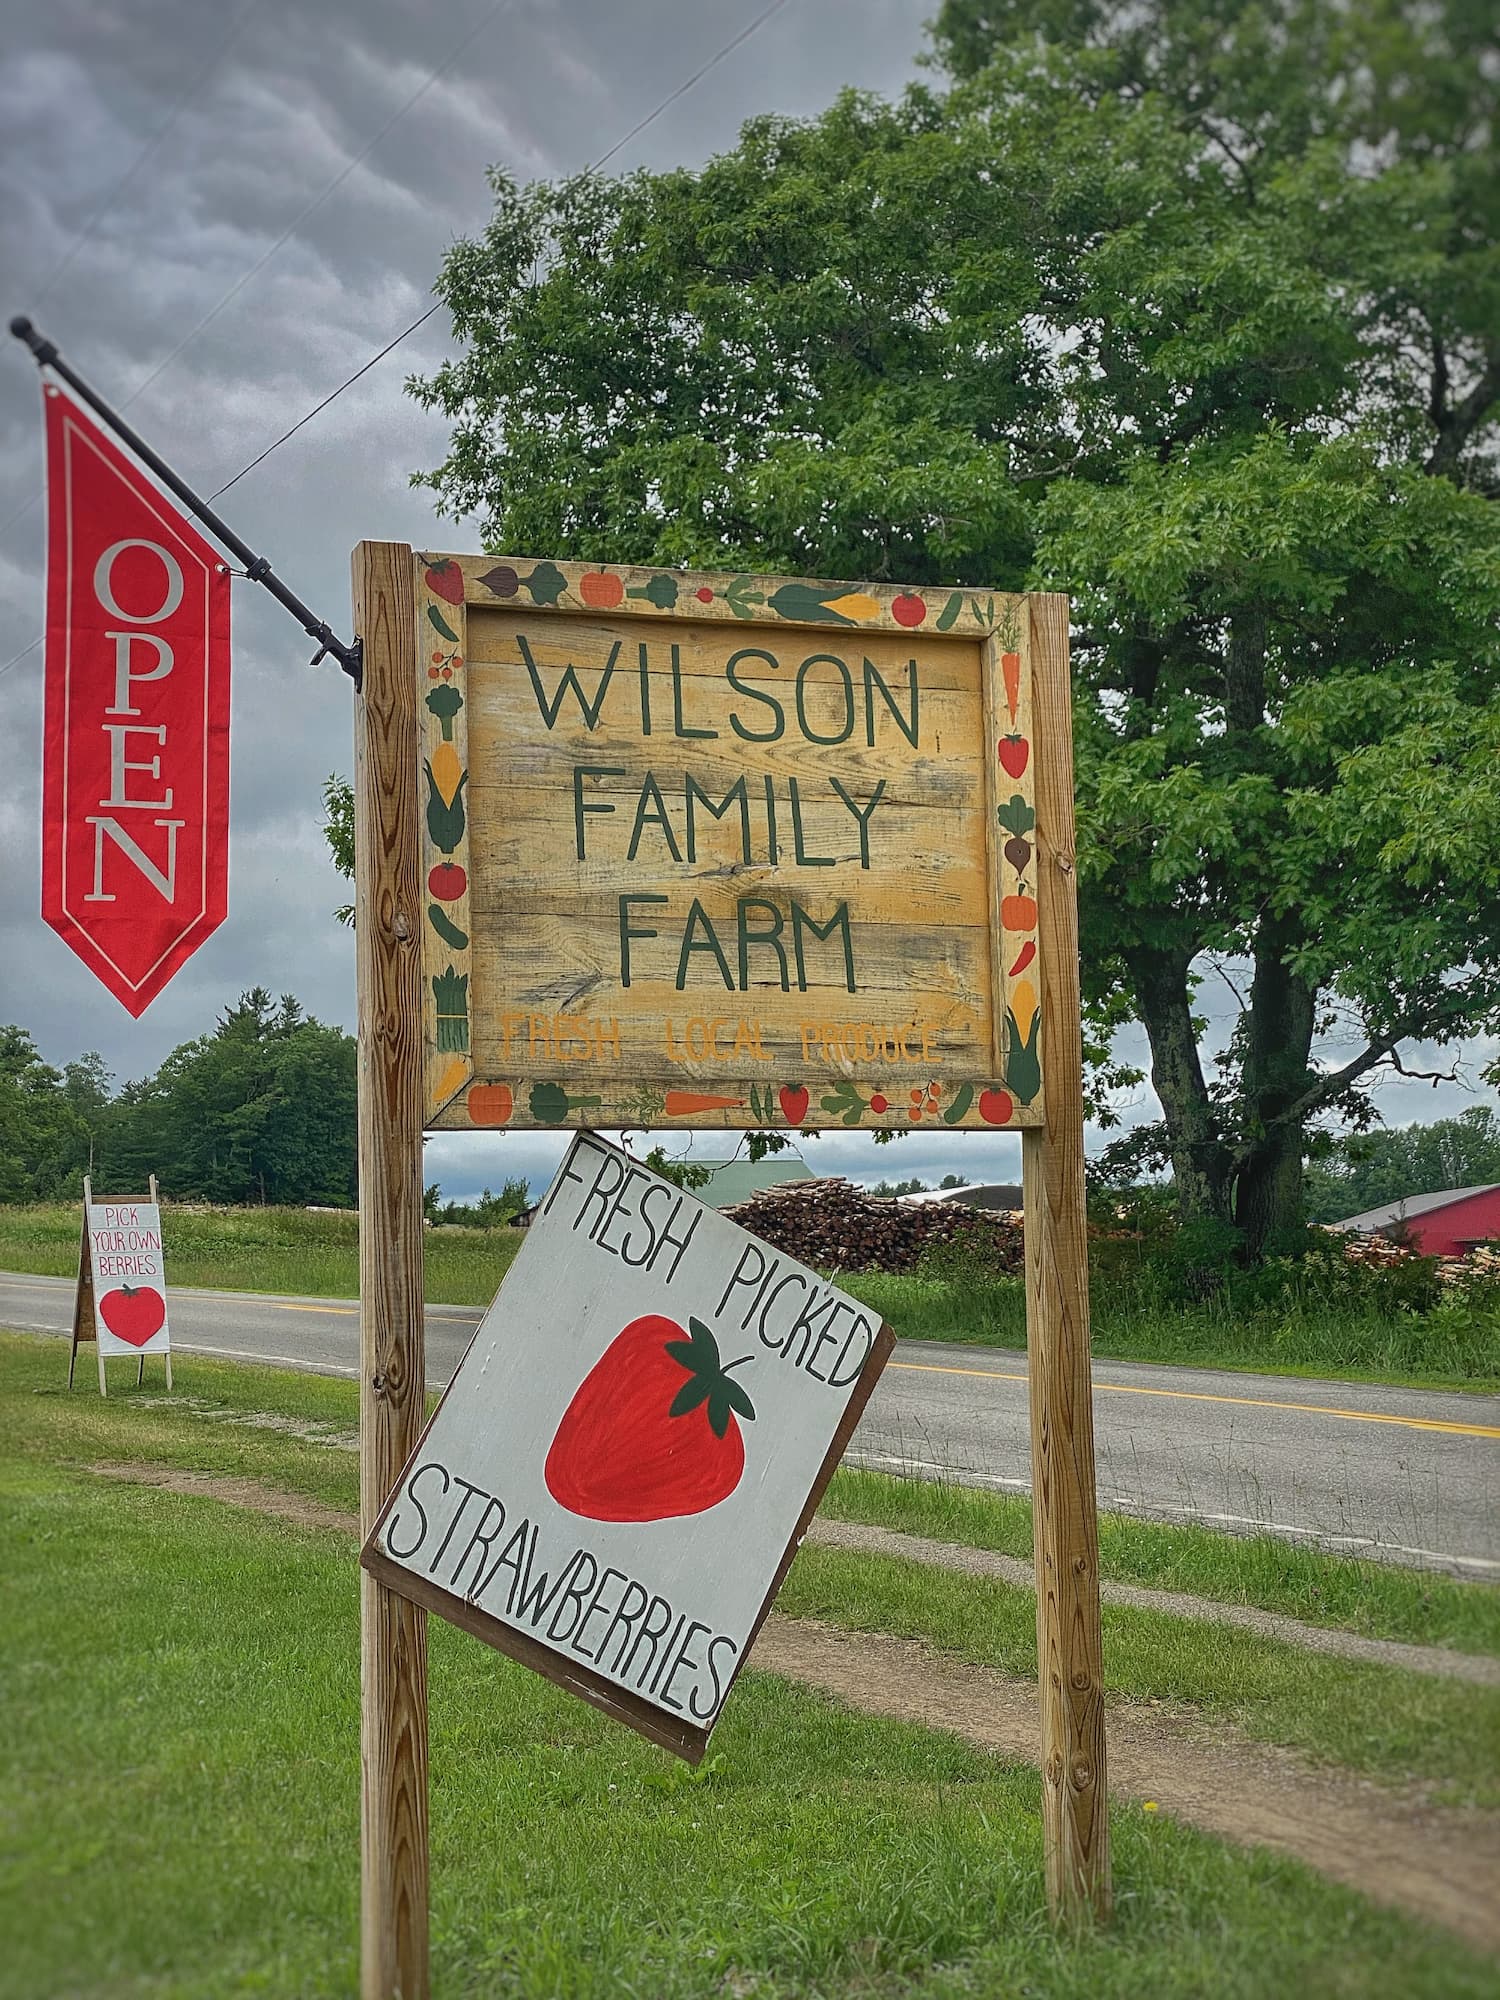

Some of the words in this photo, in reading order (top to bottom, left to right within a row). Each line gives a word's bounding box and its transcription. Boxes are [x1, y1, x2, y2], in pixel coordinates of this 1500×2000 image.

[84, 538, 185, 904] OPEN
[516, 634, 918, 749] WILSON
[574, 766, 887, 870] FAMILY
[619, 894, 856, 994] FARM
[501, 1013, 621, 1061] FRESH
[666, 1017, 775, 1062] LOCAL
[800, 1021, 944, 1064] PRODUCE
[92, 1231, 125, 1252] YOUR
[128, 1231, 160, 1251] OWN
[99, 1254, 157, 1276] BERRIES
[105, 1207, 139, 1227] PICK
[543, 1136, 703, 1284] FRESH
[715, 1242, 874, 1387] PICKED
[386, 1462, 739, 1720] STRAWBERRIES
